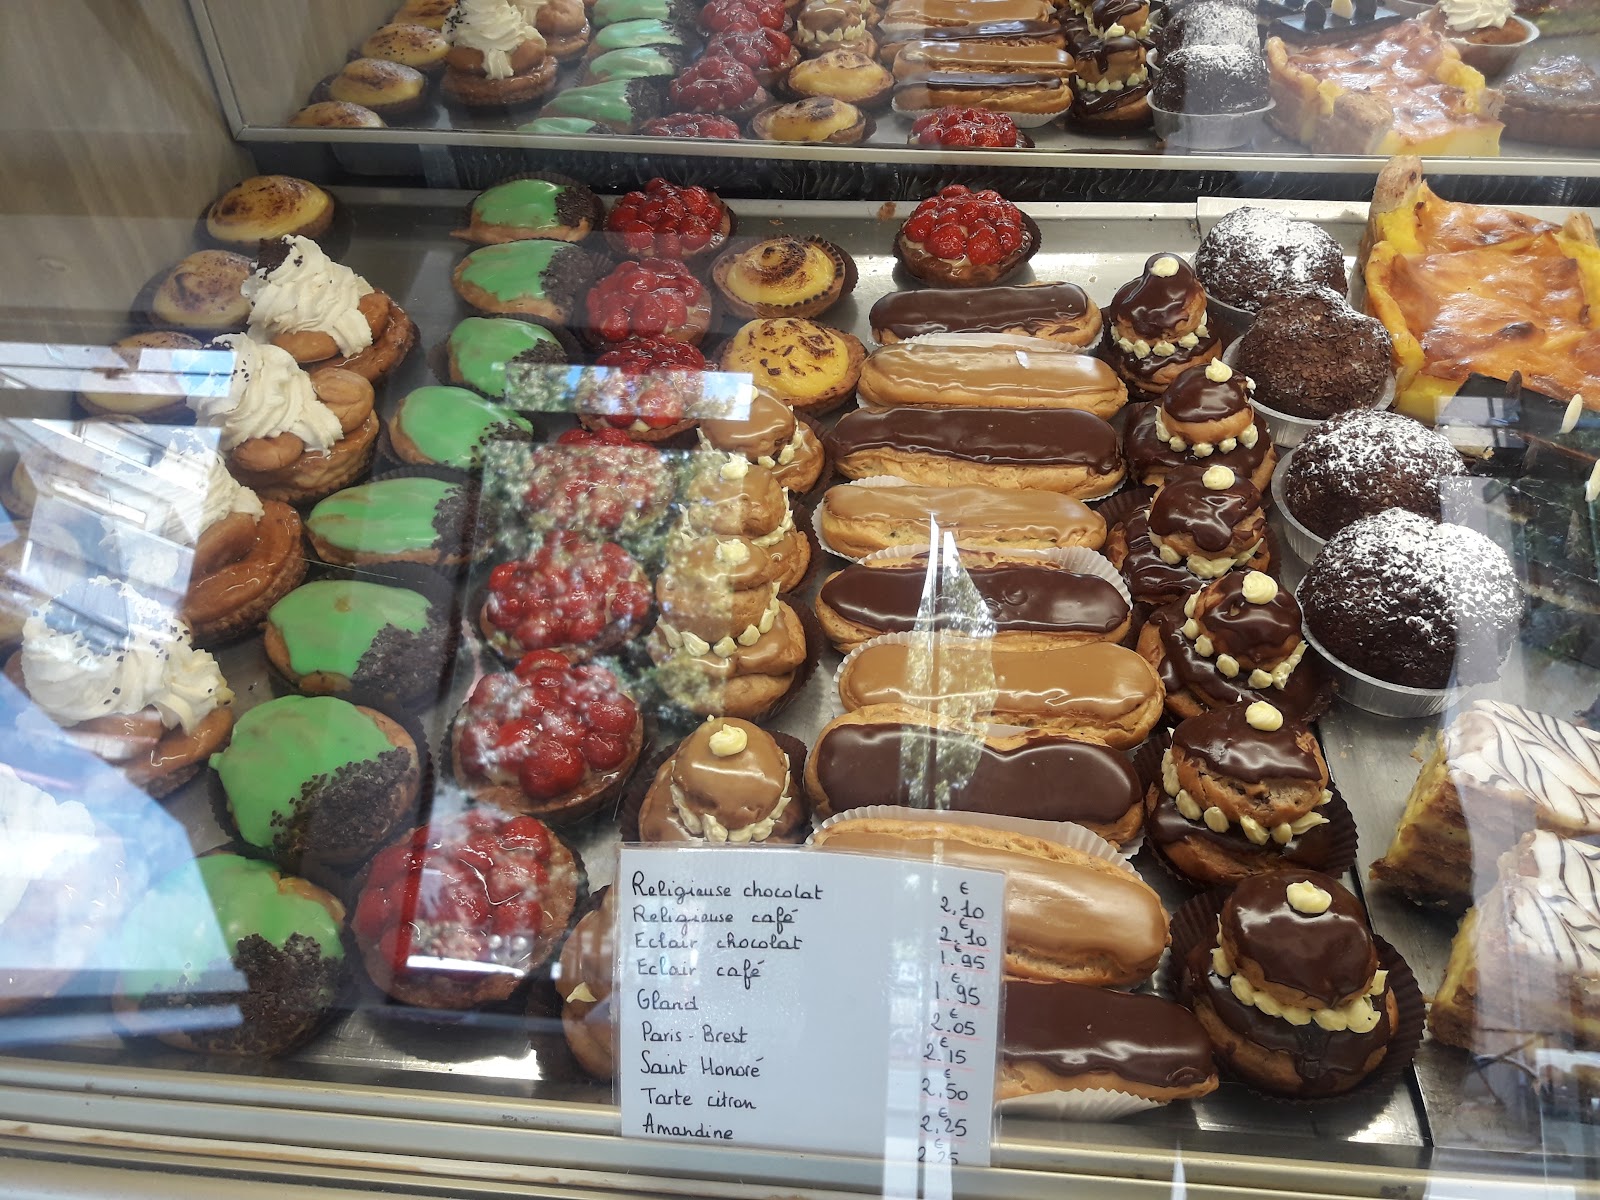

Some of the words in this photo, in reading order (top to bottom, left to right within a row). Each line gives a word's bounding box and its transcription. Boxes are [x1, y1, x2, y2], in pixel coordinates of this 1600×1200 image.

[632, 870, 732, 904] Religieuse
[744, 880, 824, 900] chocolat
[633, 904, 733, 936] Religieuse
[751, 906, 798, 934] café
[635, 932, 698, 949] Eclair
[716, 932, 803, 950] chocolat
[637, 956, 697, 976] Eclair
[717, 958, 764, 989] café
[637, 988, 699, 1010] Gland
[702, 1024, 748, 1043] Brest
[640, 1050, 687, 1075] Saint
[701, 1056, 764, 1078] Honoré
[640, 1087, 693, 1106] Tarte
[707, 1090, 757, 1109] citron
[642, 1112, 733, 1139] Amandine
